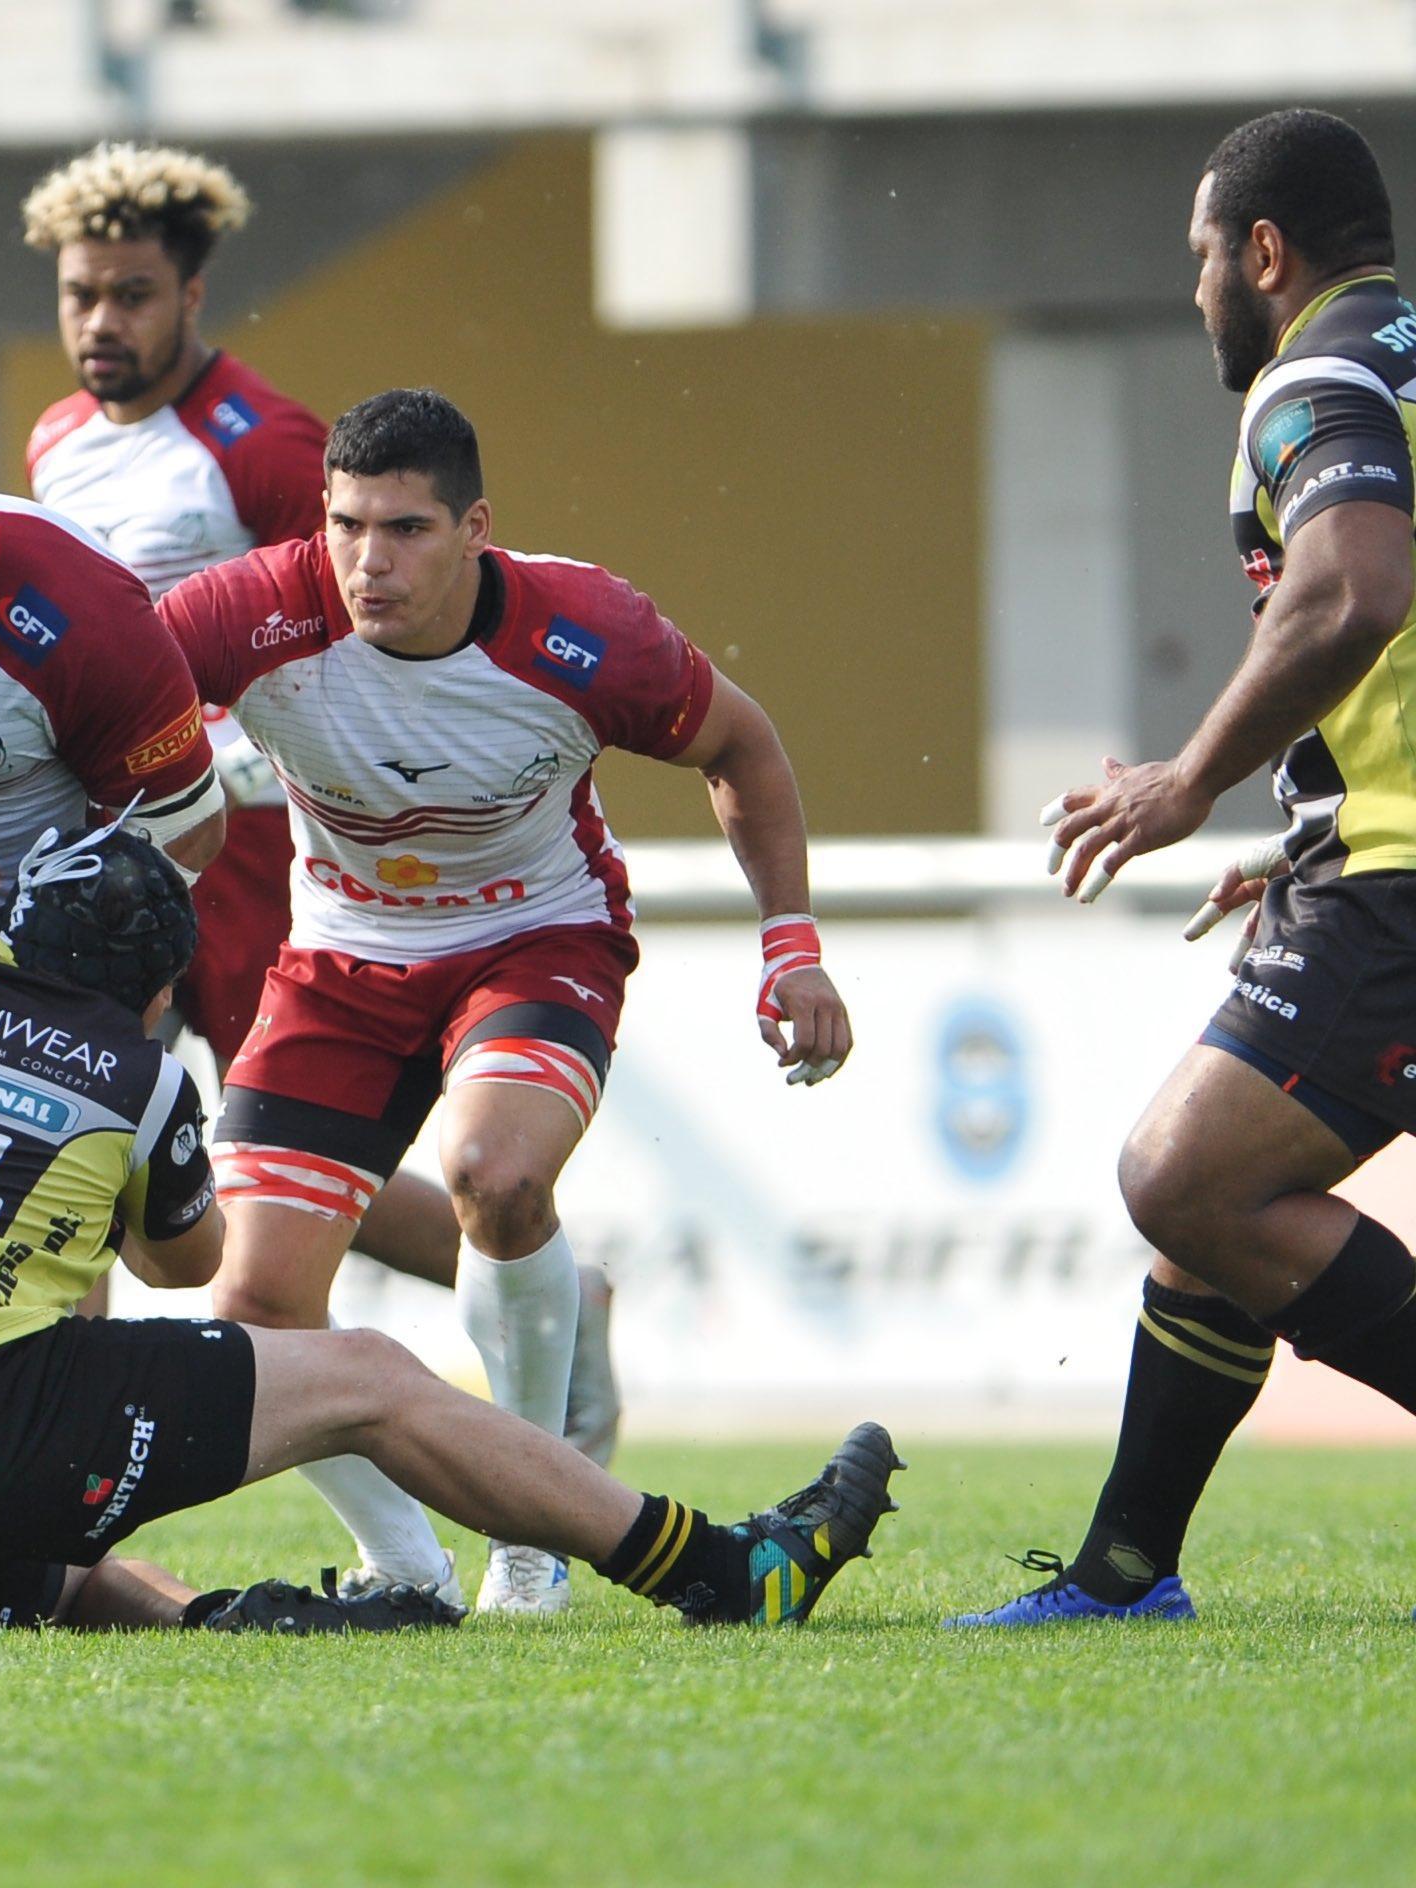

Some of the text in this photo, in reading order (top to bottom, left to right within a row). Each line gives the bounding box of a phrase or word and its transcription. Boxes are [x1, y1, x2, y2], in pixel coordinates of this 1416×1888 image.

[1371, 312, 1416, 352] STO
[9, 605, 56, 646] CFT
[546, 634, 598, 669] CFT
[20, 1056, 91, 1090] CONCEPT
